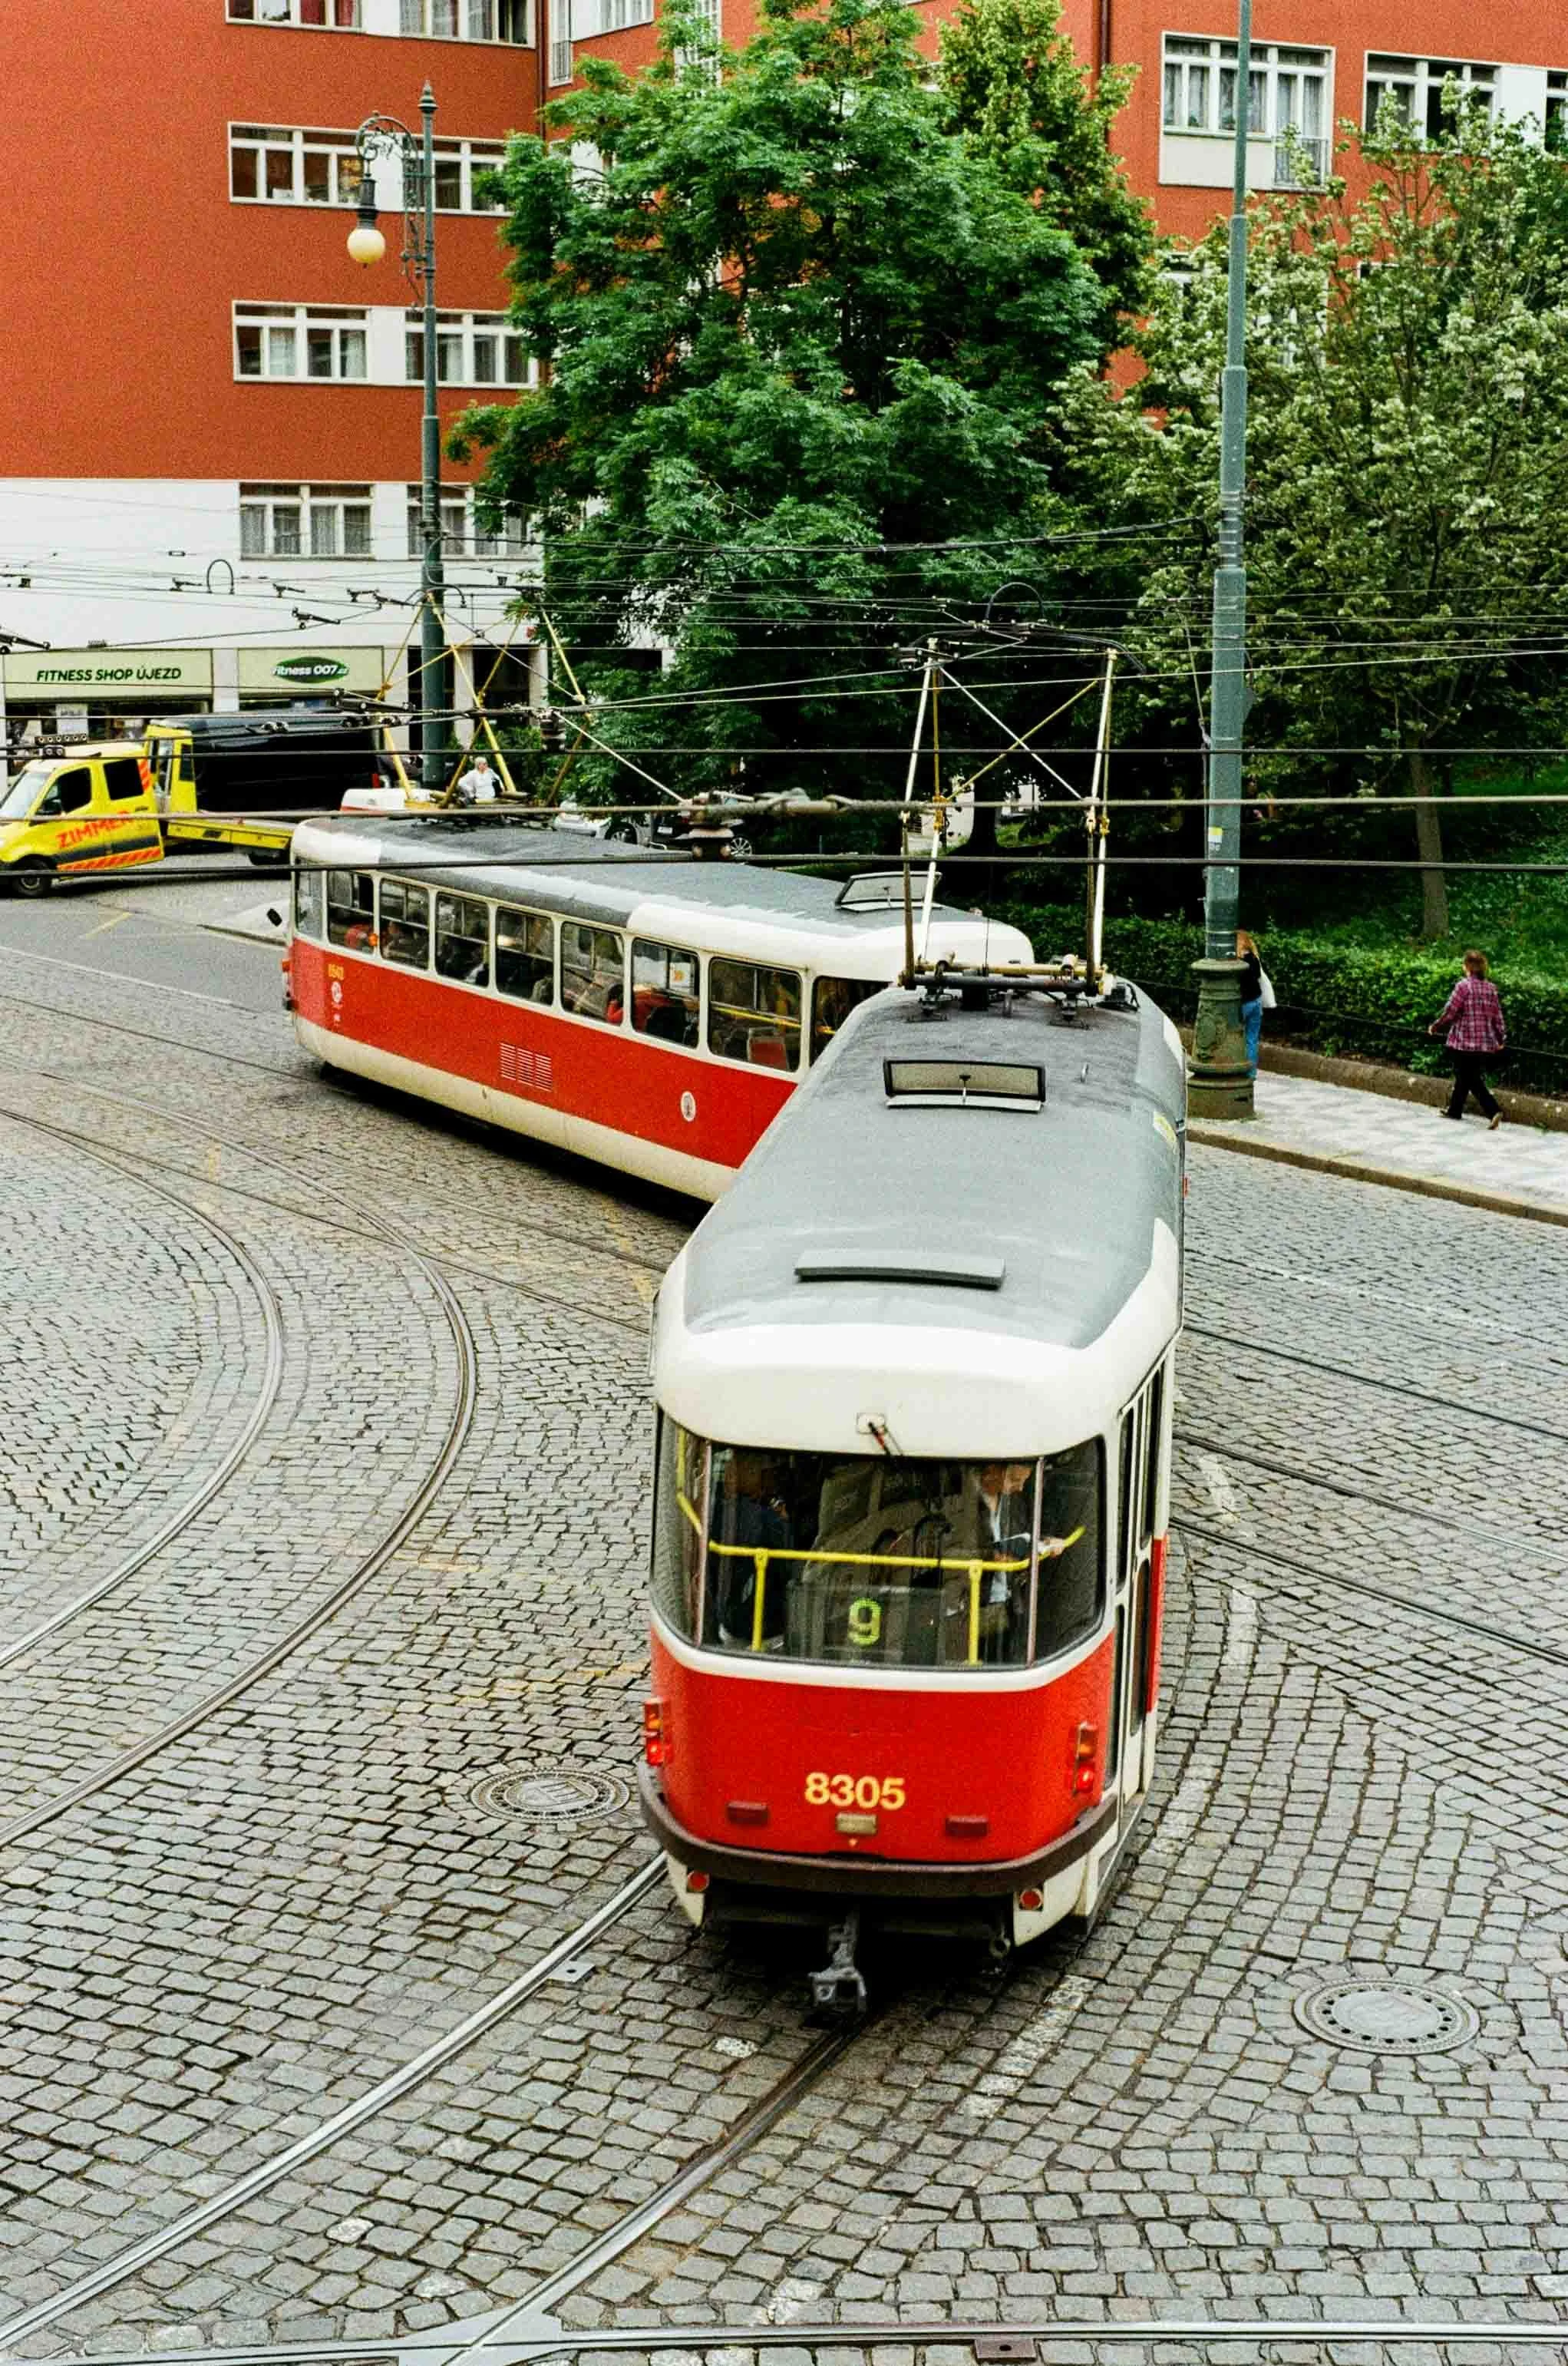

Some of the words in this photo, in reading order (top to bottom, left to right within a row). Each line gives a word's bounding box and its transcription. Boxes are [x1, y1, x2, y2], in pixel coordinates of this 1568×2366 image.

[37, 669, 93, 682] FITNESS
[95, 669, 134, 681] SHOP
[136, 666, 182, 680] ÚJEZD
[848, 1597, 881, 1647] 9
[804, 1772, 906, 1810] 8305
